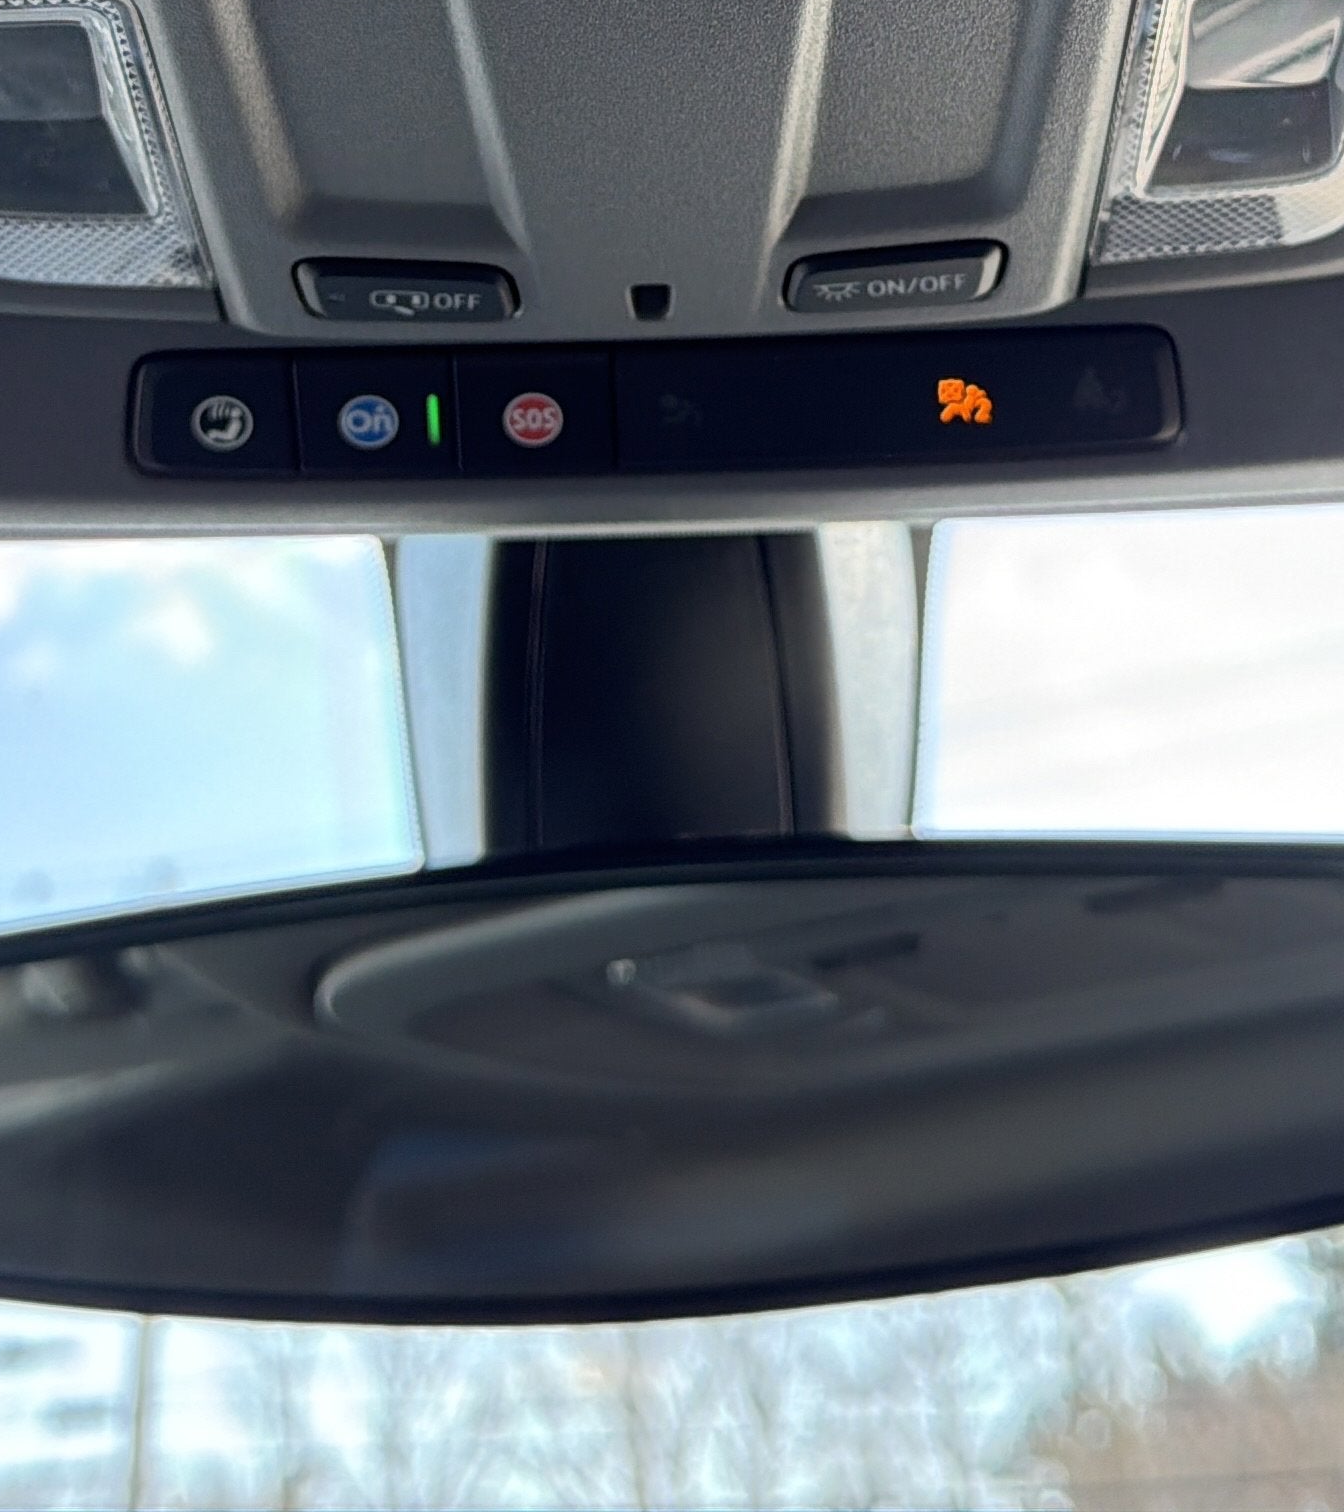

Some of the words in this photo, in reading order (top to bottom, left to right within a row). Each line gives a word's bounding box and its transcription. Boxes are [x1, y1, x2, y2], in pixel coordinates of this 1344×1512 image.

[867, 274, 967, 297] ON/OFF
[433, 292, 480, 310] OFF
[511, 406, 556, 431] SOS
